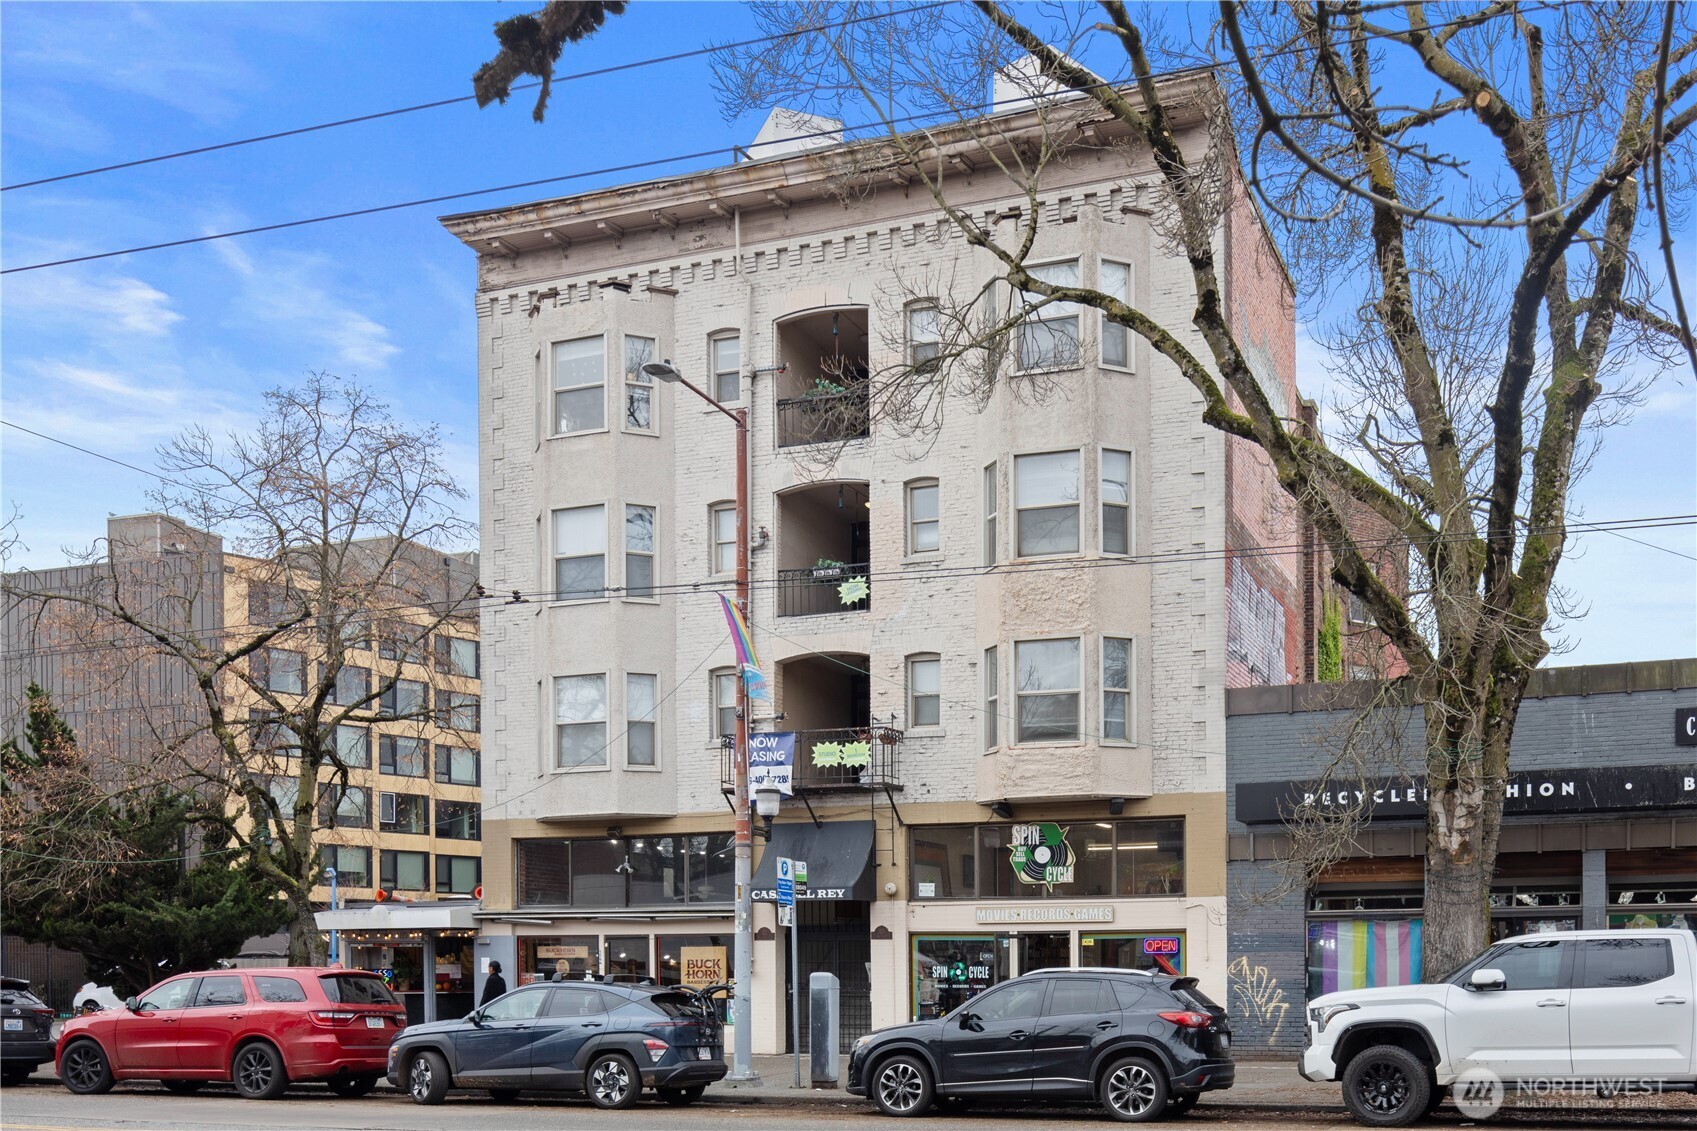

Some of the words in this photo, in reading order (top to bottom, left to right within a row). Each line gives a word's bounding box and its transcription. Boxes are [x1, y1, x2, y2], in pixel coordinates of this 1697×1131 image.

[749, 737, 778, 748] NOW
[749, 750, 786, 762] ASING
[1012, 825, 1040, 845] SPIN
[1046, 866, 1073, 882] CYCLE
[751, 890, 778, 899] CAS
[817, 889, 846, 898] REY
[976, 909, 1018, 921] MOVIES
[1020, 908, 1071, 921] RECORDS
[1074, 907, 1112, 920] GAMES
[1145, 940, 1176, 951] OPEN
[687, 959, 722, 969] BUCK
[685, 969, 721, 980] HORN
[932, 965, 948, 978] SPIN
[968, 966, 989, 979] CYCLE
